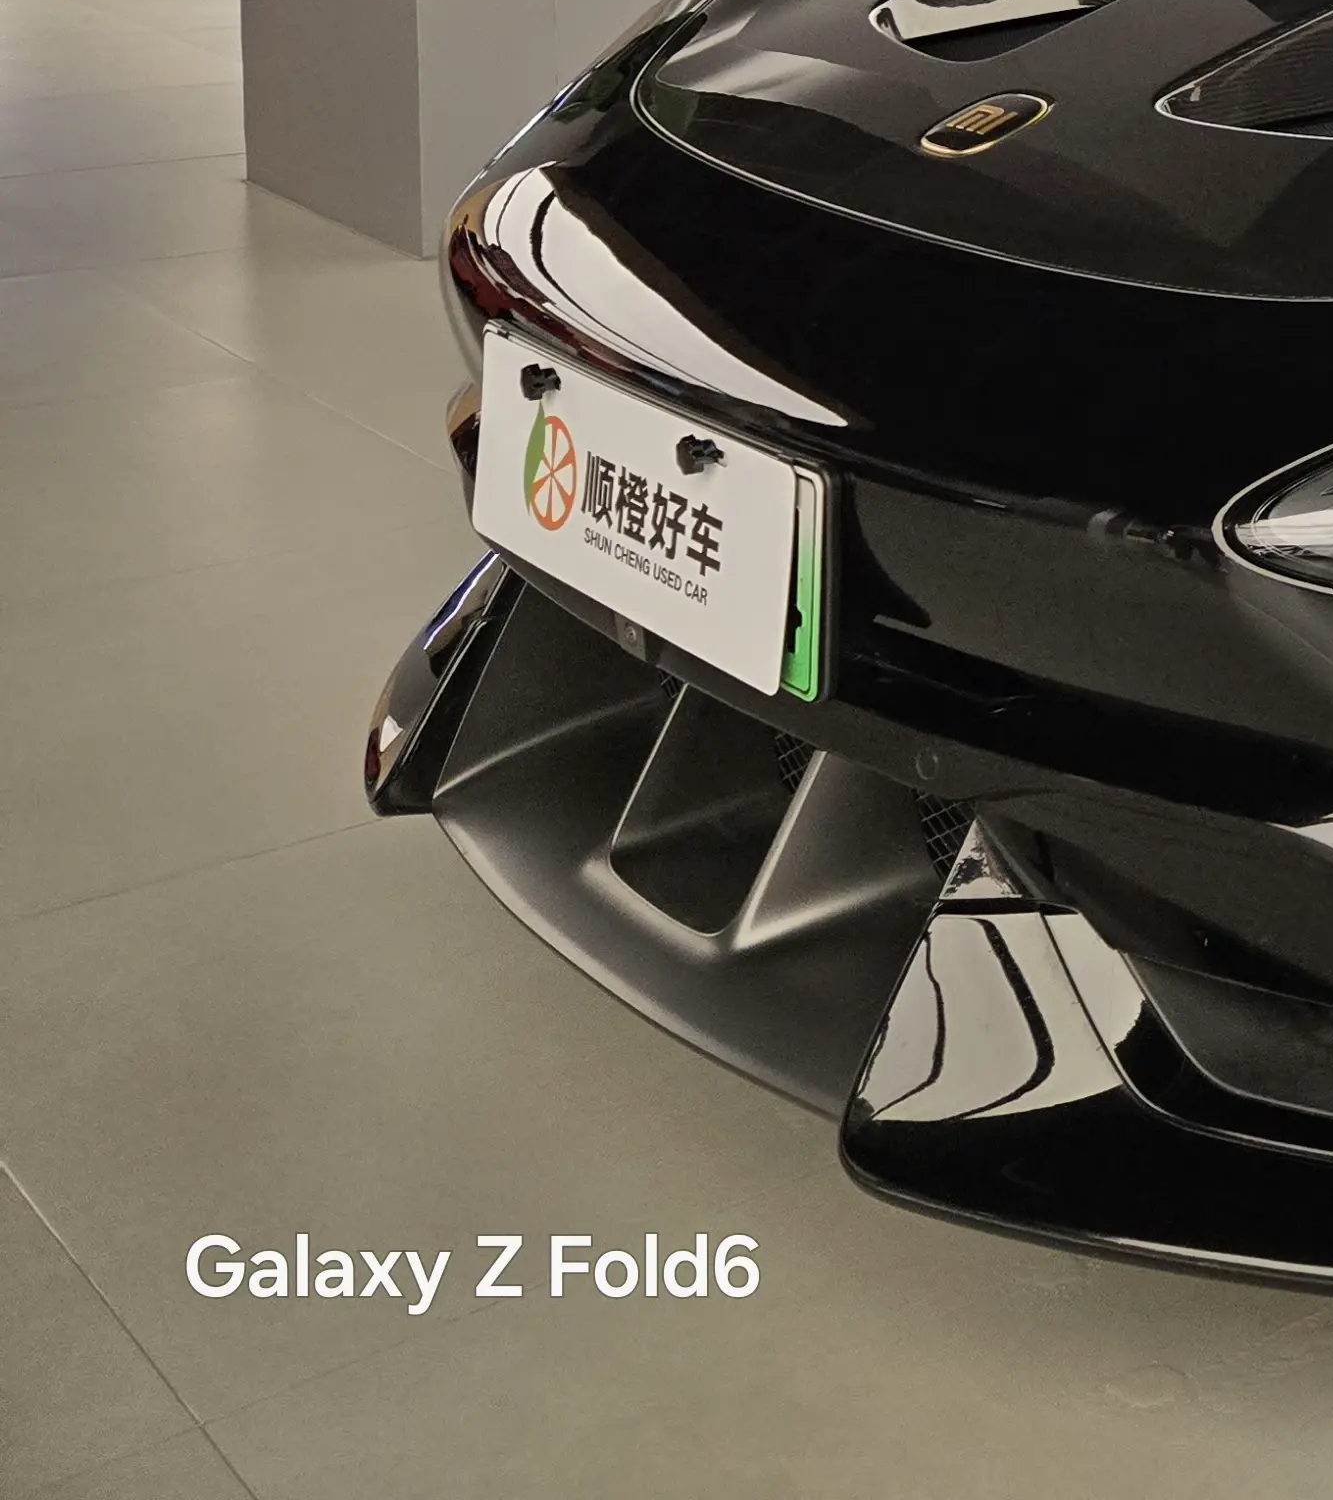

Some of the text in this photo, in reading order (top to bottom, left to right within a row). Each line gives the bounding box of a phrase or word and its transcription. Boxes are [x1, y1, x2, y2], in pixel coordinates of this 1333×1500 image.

[581, 451, 723, 577] 顺橙好车
[584, 527, 708, 606] SHUN CHENG USED CAR
